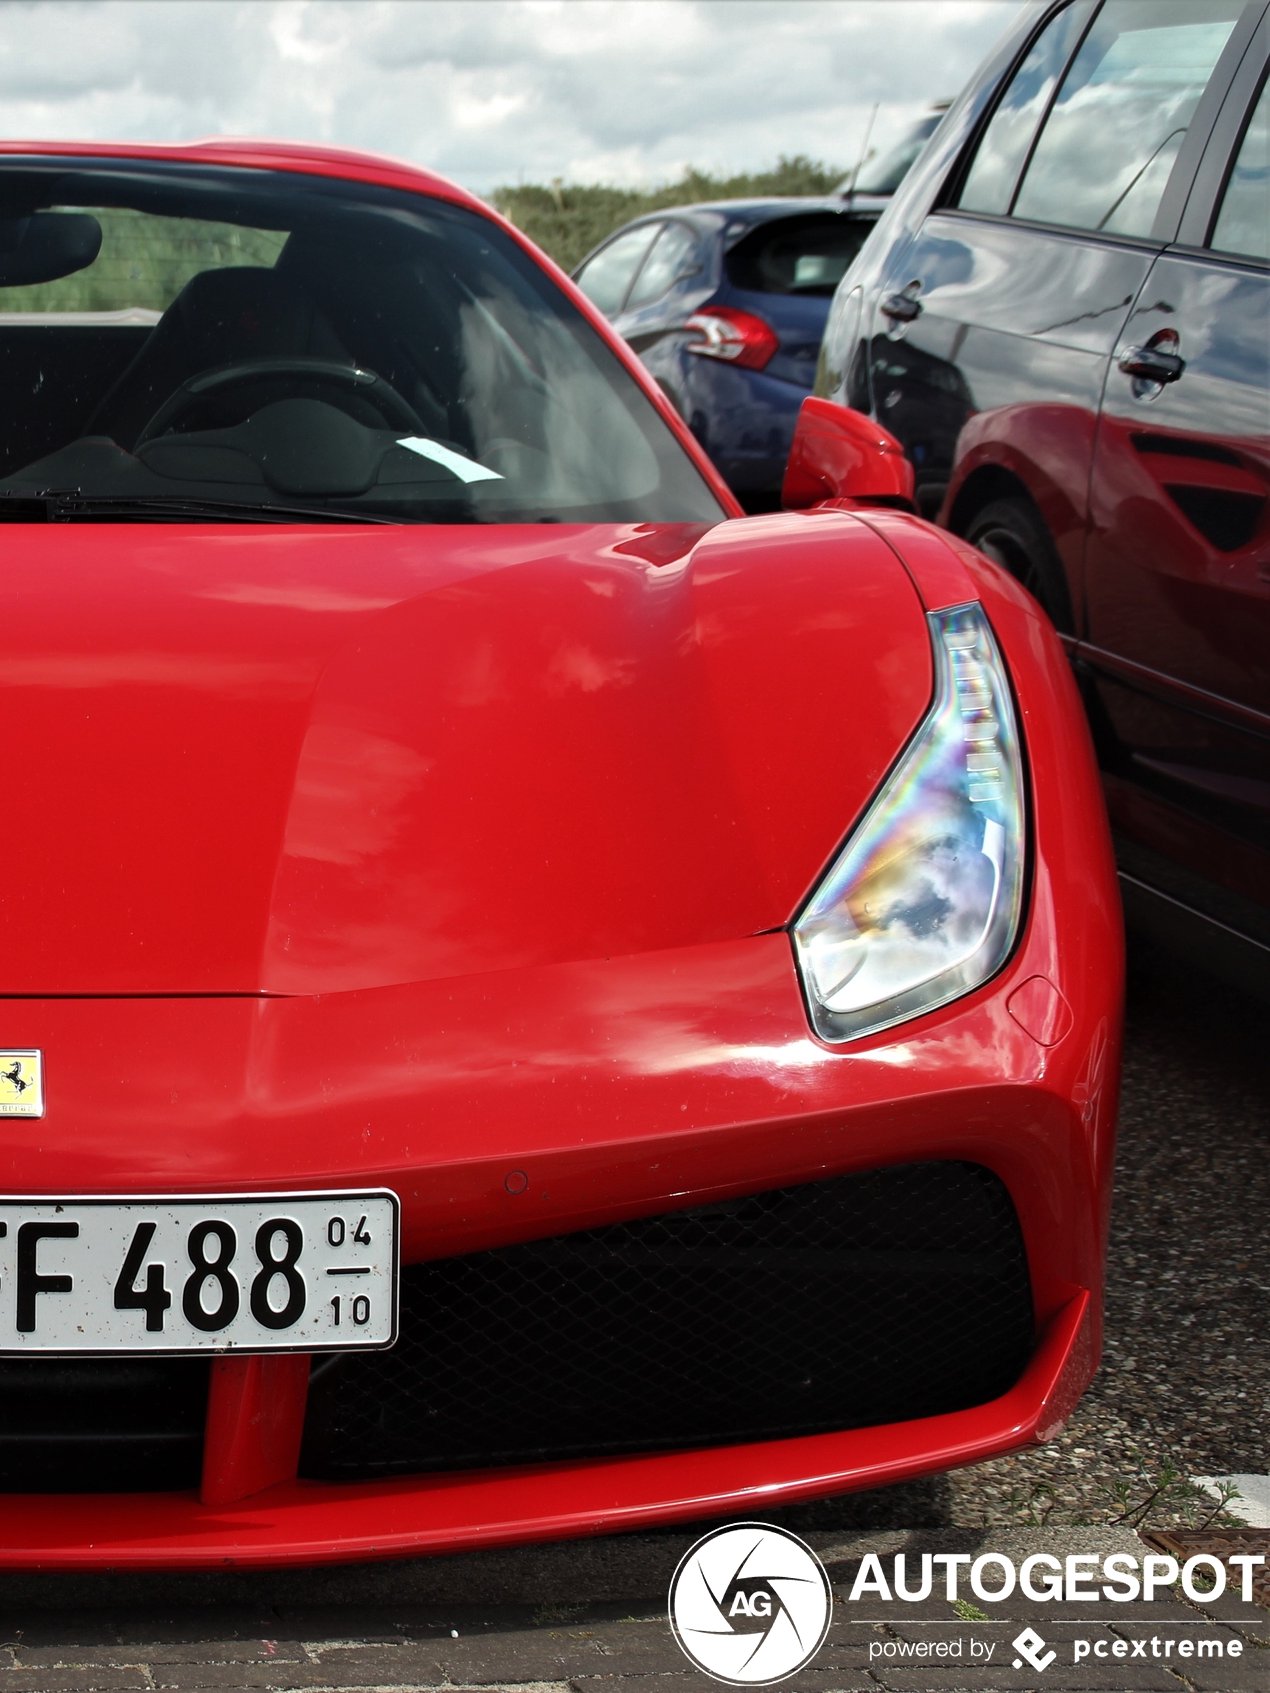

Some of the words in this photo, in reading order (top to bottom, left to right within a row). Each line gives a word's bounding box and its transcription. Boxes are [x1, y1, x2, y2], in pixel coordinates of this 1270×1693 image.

[328, 1215, 371, 1247] 04
[114, 1217, 306, 1332] 488
[331, 1295, 371, 1325] 10
